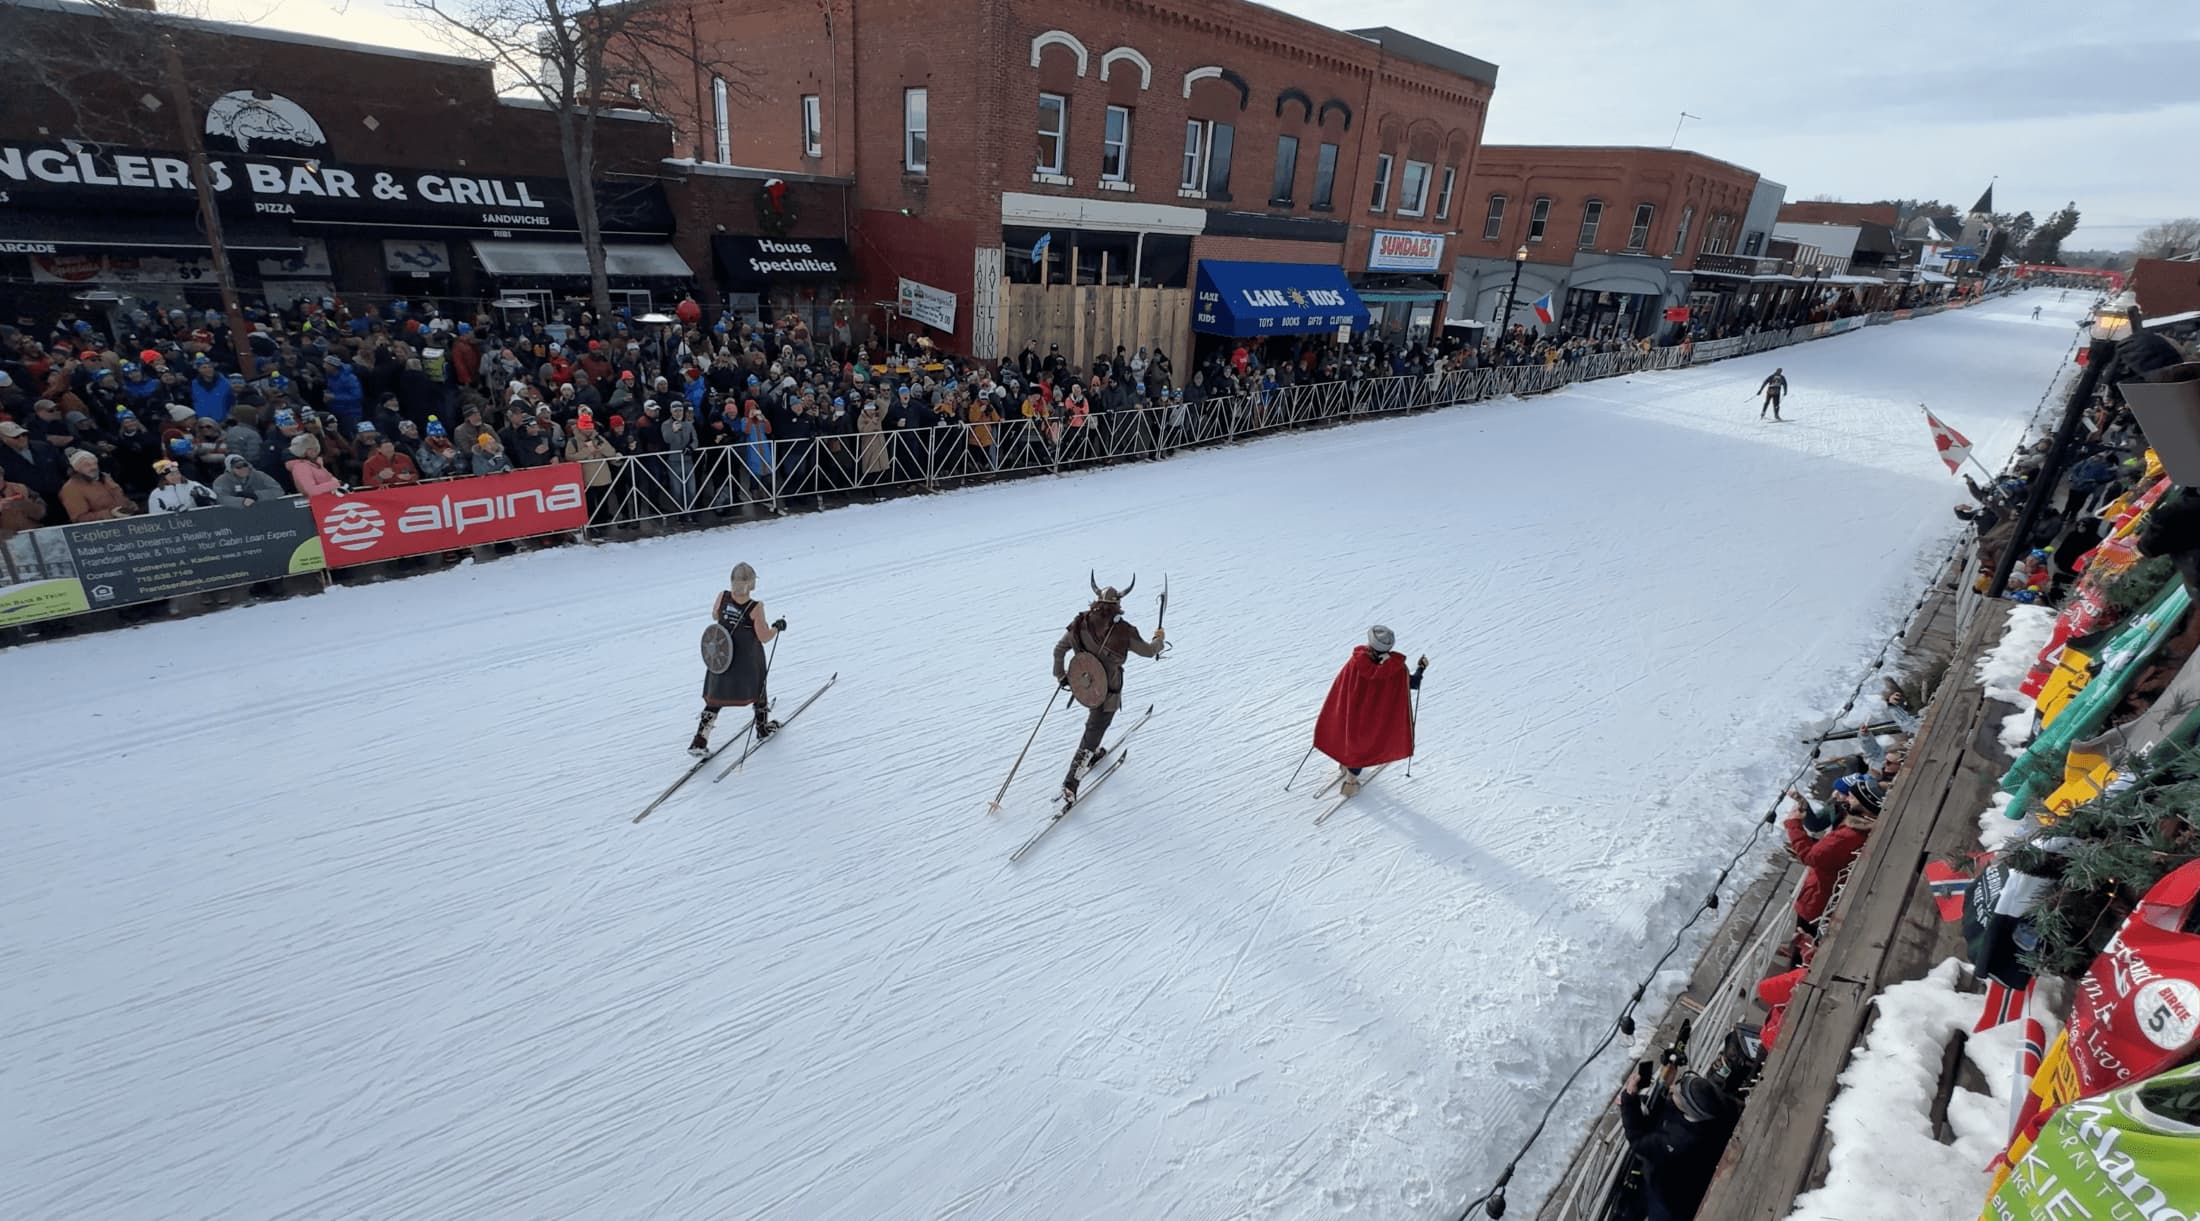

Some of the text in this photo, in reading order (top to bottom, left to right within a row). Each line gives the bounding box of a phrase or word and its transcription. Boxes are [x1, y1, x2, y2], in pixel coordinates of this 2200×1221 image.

[245, 163, 361, 199] BAR
[372, 172, 408, 200] &
[416, 175, 545, 208] GRILL
[255, 202, 295, 214] PIZZA
[482, 213, 550, 226] SANDWICHES
[758, 239, 812, 254] House
[749, 258, 837, 274] Specialties
[1199, 292, 1219, 303] LAKE
[1241, 289, 1346, 308] LAKE KIDS
[1198, 313, 1216, 324] KIDS
[1259, 317, 1274, 328] TOYS
[1282, 316, 1300, 328] BOOKS
[1307, 316, 1323, 326] GIFTS
[398, 483, 582, 534] alpina
[77, 546, 105, 556] Make
[107, 542, 135, 553] Cabin
[137, 537, 173, 548] Dreams
[182, 531, 212, 541] Reality
[214, 528, 232, 537] with
[81, 555, 127, 567] Frandsen
[127, 551, 151, 561] Bank
[165, 545, 187, 555] Trust
[198, 541, 217, 551] Your
[219, 537, 243, 548] Cabin
[245, 533, 265, 544] Loan
[267, 529, 297, 541] Experts
[2157, 986, 2192, 1023] BIRKIE
[2148, 1005, 2172, 1033] 5
[2087, 1026, 2131, 1082] Live
